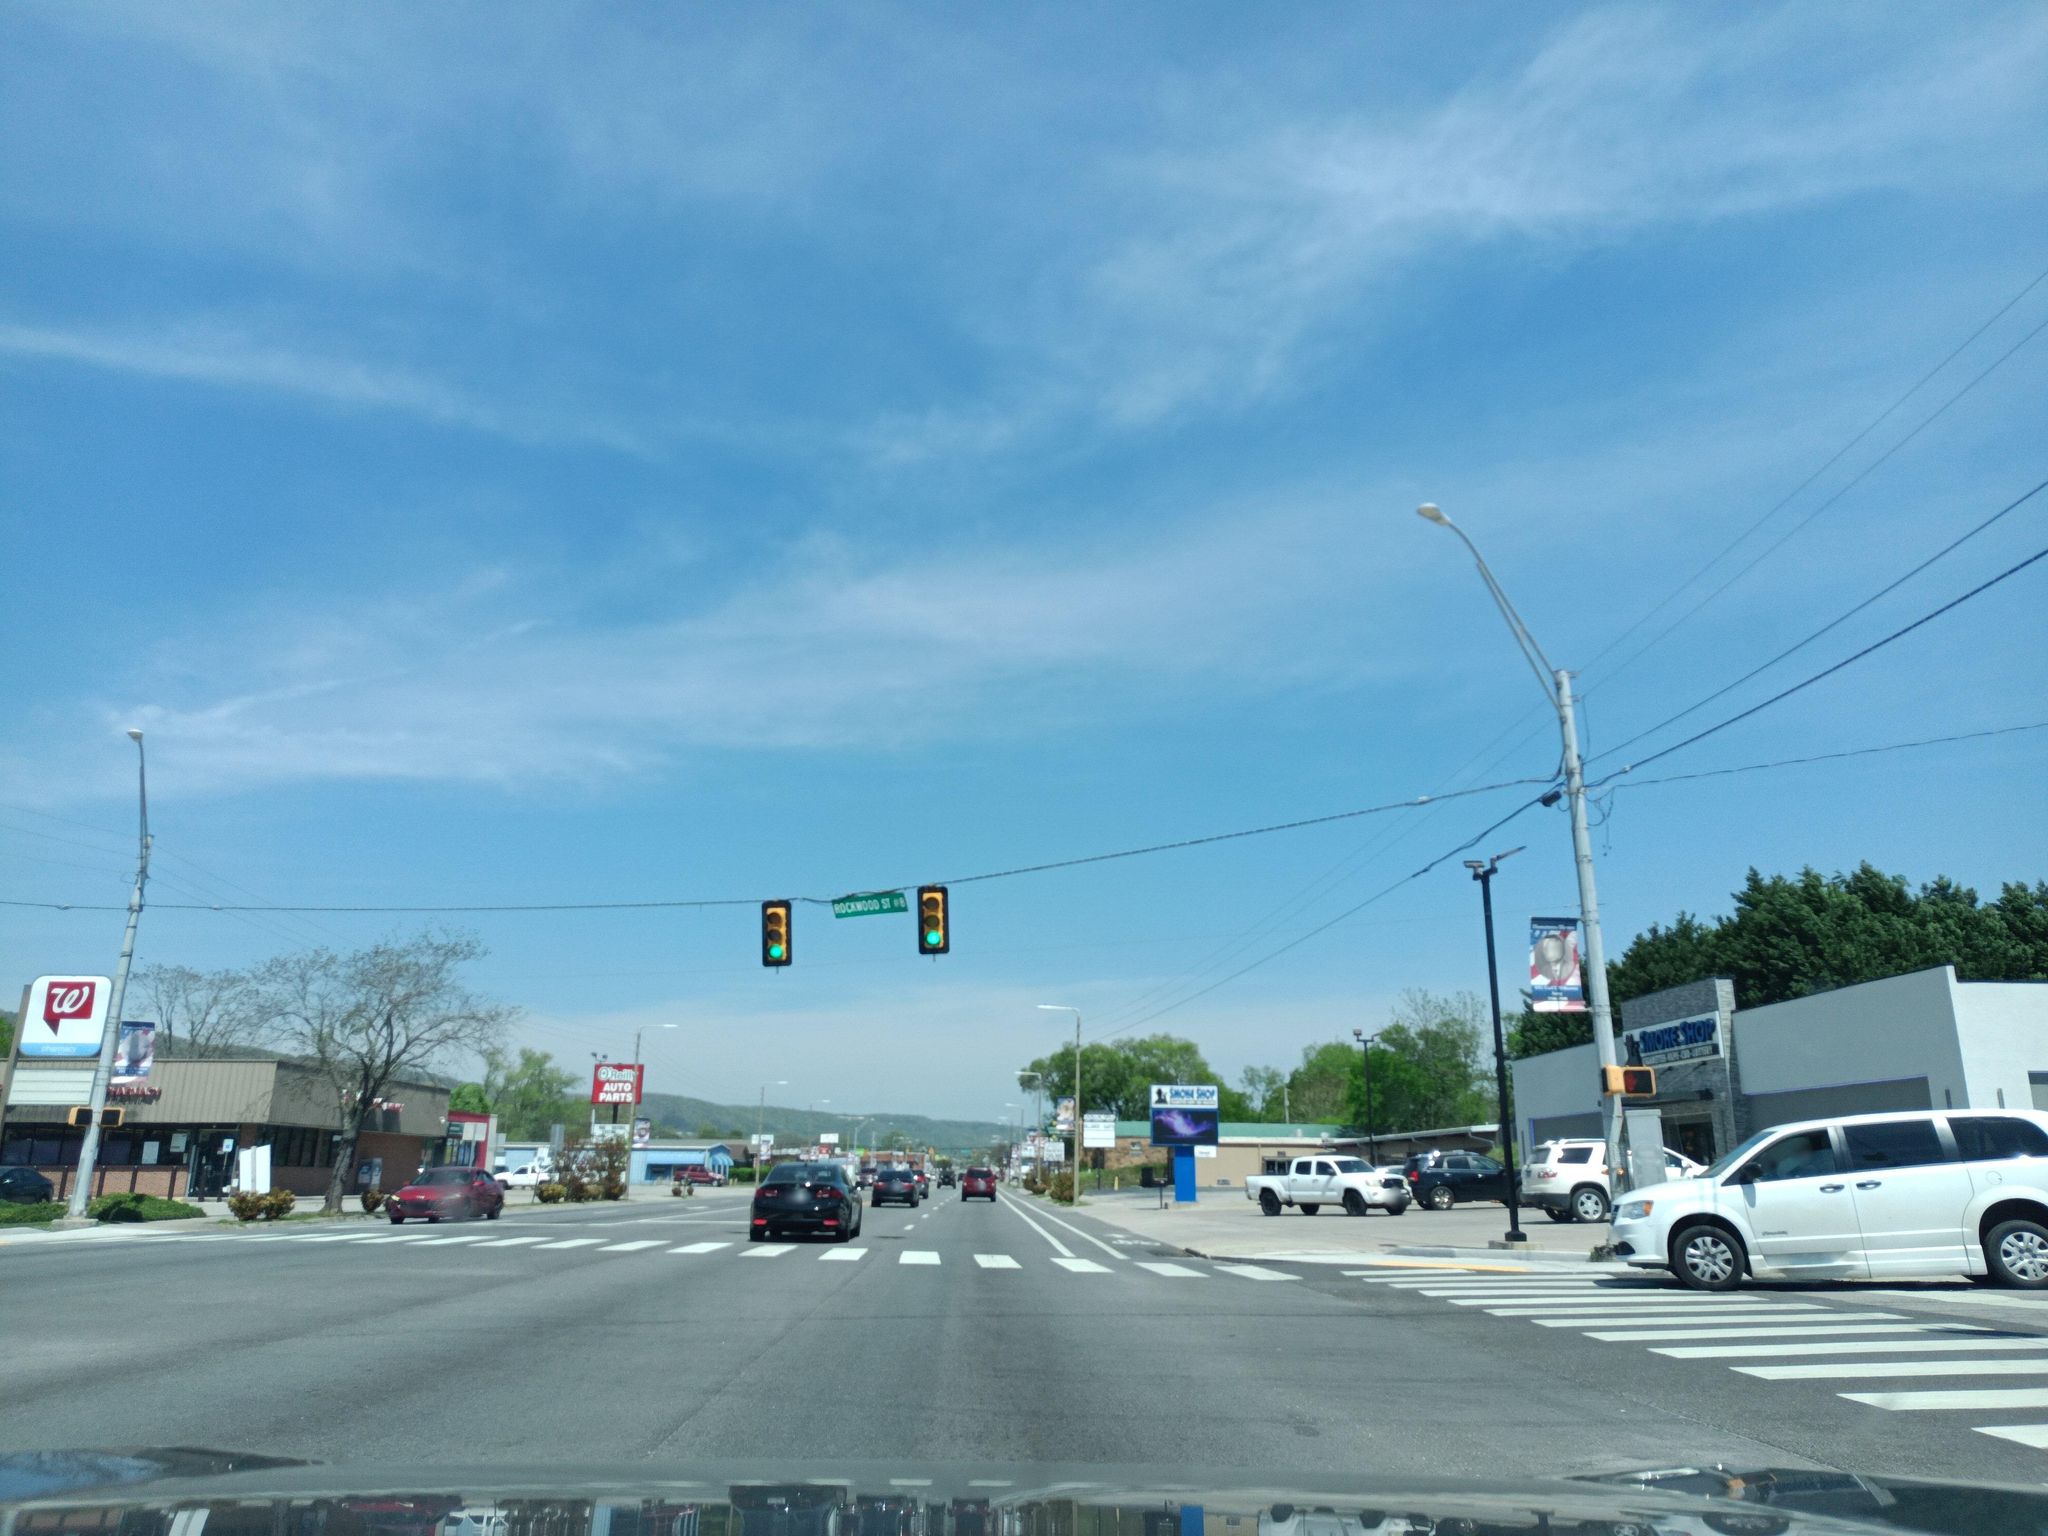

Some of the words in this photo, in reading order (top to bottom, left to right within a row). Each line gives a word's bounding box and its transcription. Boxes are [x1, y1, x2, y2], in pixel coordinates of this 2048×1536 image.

[835, 900, 880, 914] ROCKWOOD
[881, 898, 891, 909] ST
[51, 986, 90, 1013] W
[1640, 1028, 1680, 1053] SMOKE
[1680, 1018, 1716, 1045] SHOP
[603, 1083, 632, 1092] AUTO
[1170, 1088, 1194, 1099] SMOKE
[1197, 1087, 1215, 1099] SHOP
[599, 1092, 633, 1102] PARTS
